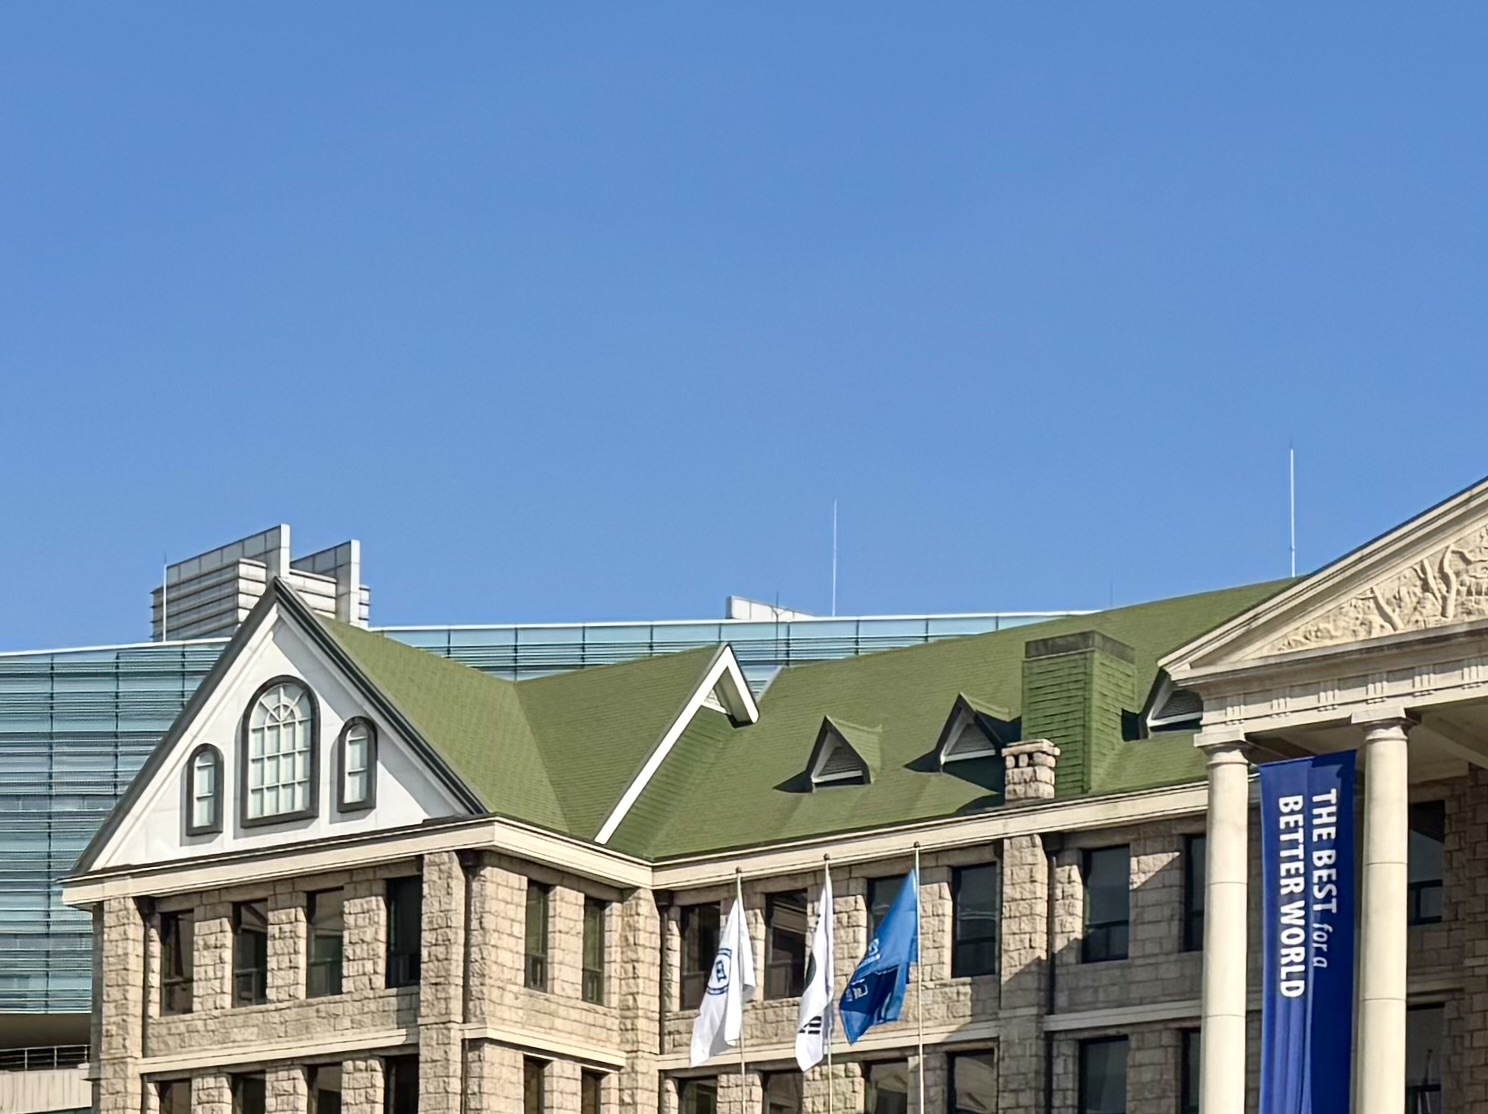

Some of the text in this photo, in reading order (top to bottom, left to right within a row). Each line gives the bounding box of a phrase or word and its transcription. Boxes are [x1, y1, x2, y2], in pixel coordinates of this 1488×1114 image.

[1279, 795, 1306, 998] BETTER WORLD
[1312, 788, 1337, 968] THE BEST for a
